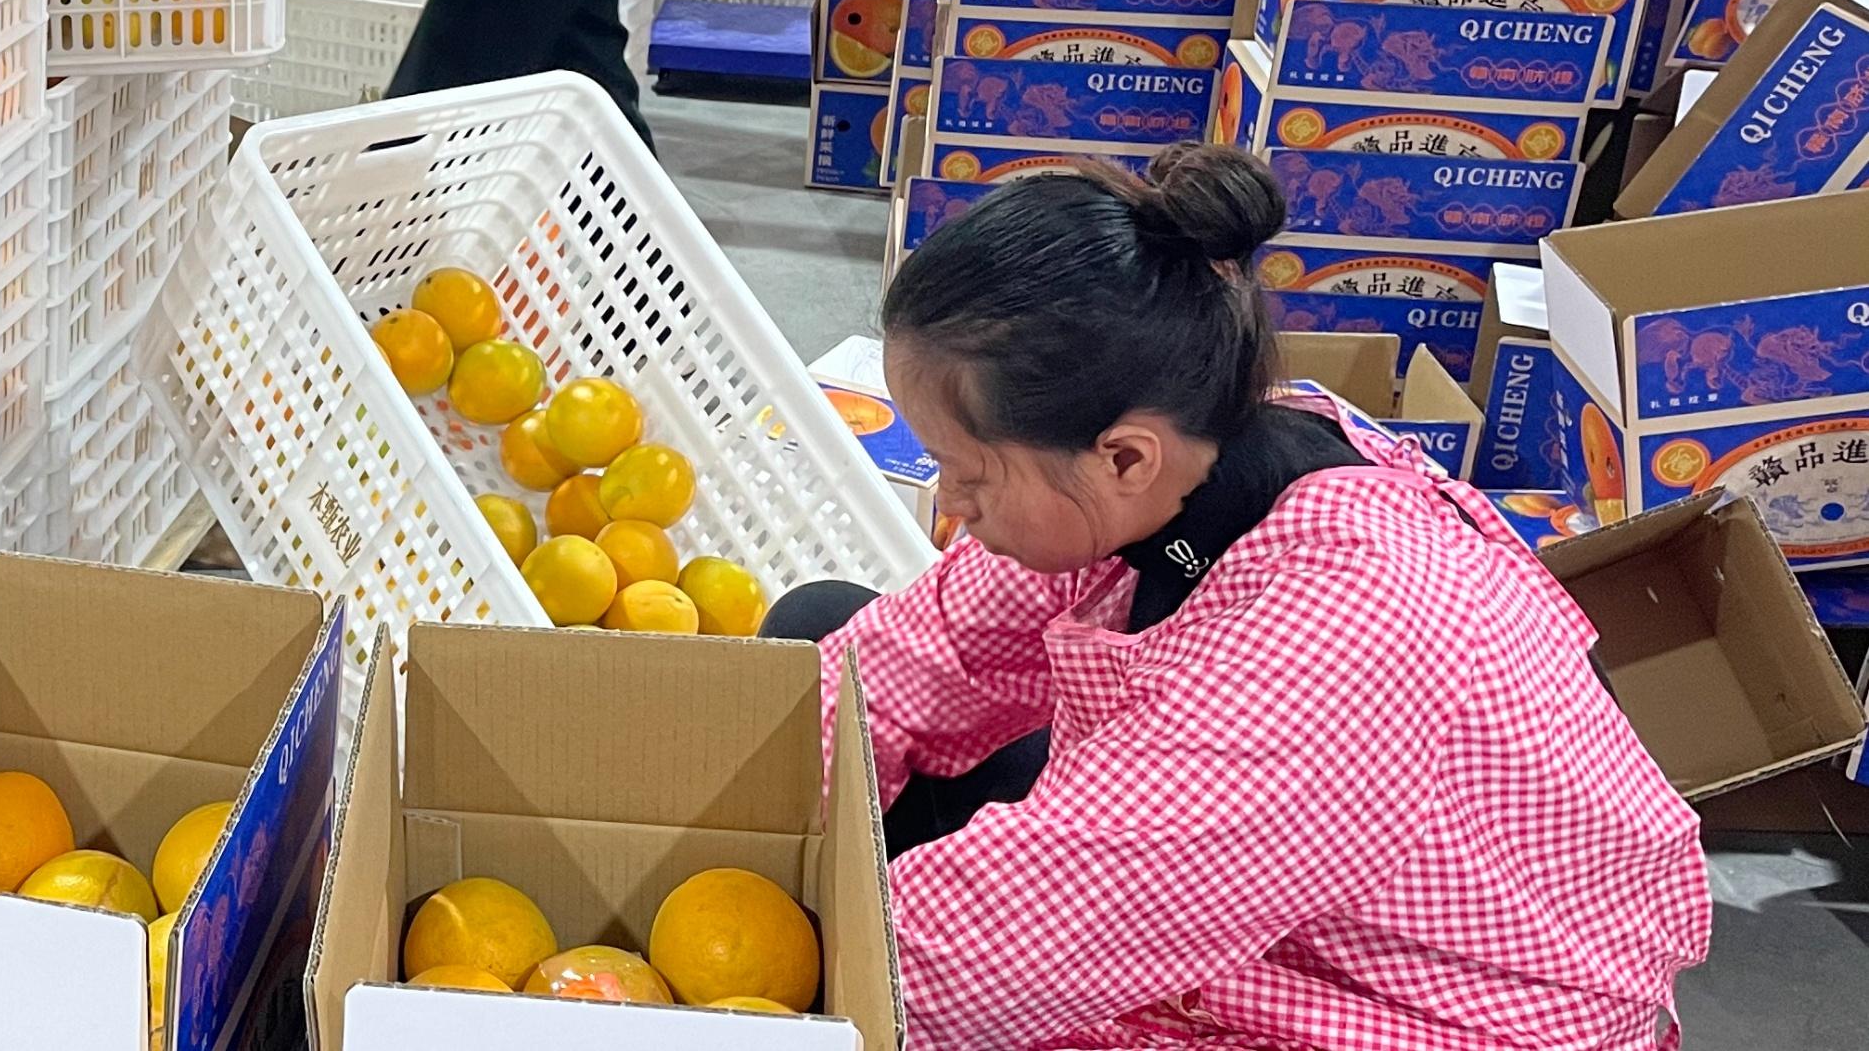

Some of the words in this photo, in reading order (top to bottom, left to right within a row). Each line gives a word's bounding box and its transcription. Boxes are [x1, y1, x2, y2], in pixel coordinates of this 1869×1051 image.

[1459, 19, 1593, 45] QICHENG
[1087, 73, 1204, 95] QICHENG
[1739, 24, 1847, 146] QICHENG
[1433, 166, 1565, 191] QICHENG
[1492, 354, 1535, 471] QICHENG
[307, 480, 363, 569] 本甄农业
[276, 638, 341, 786] QICHENG
